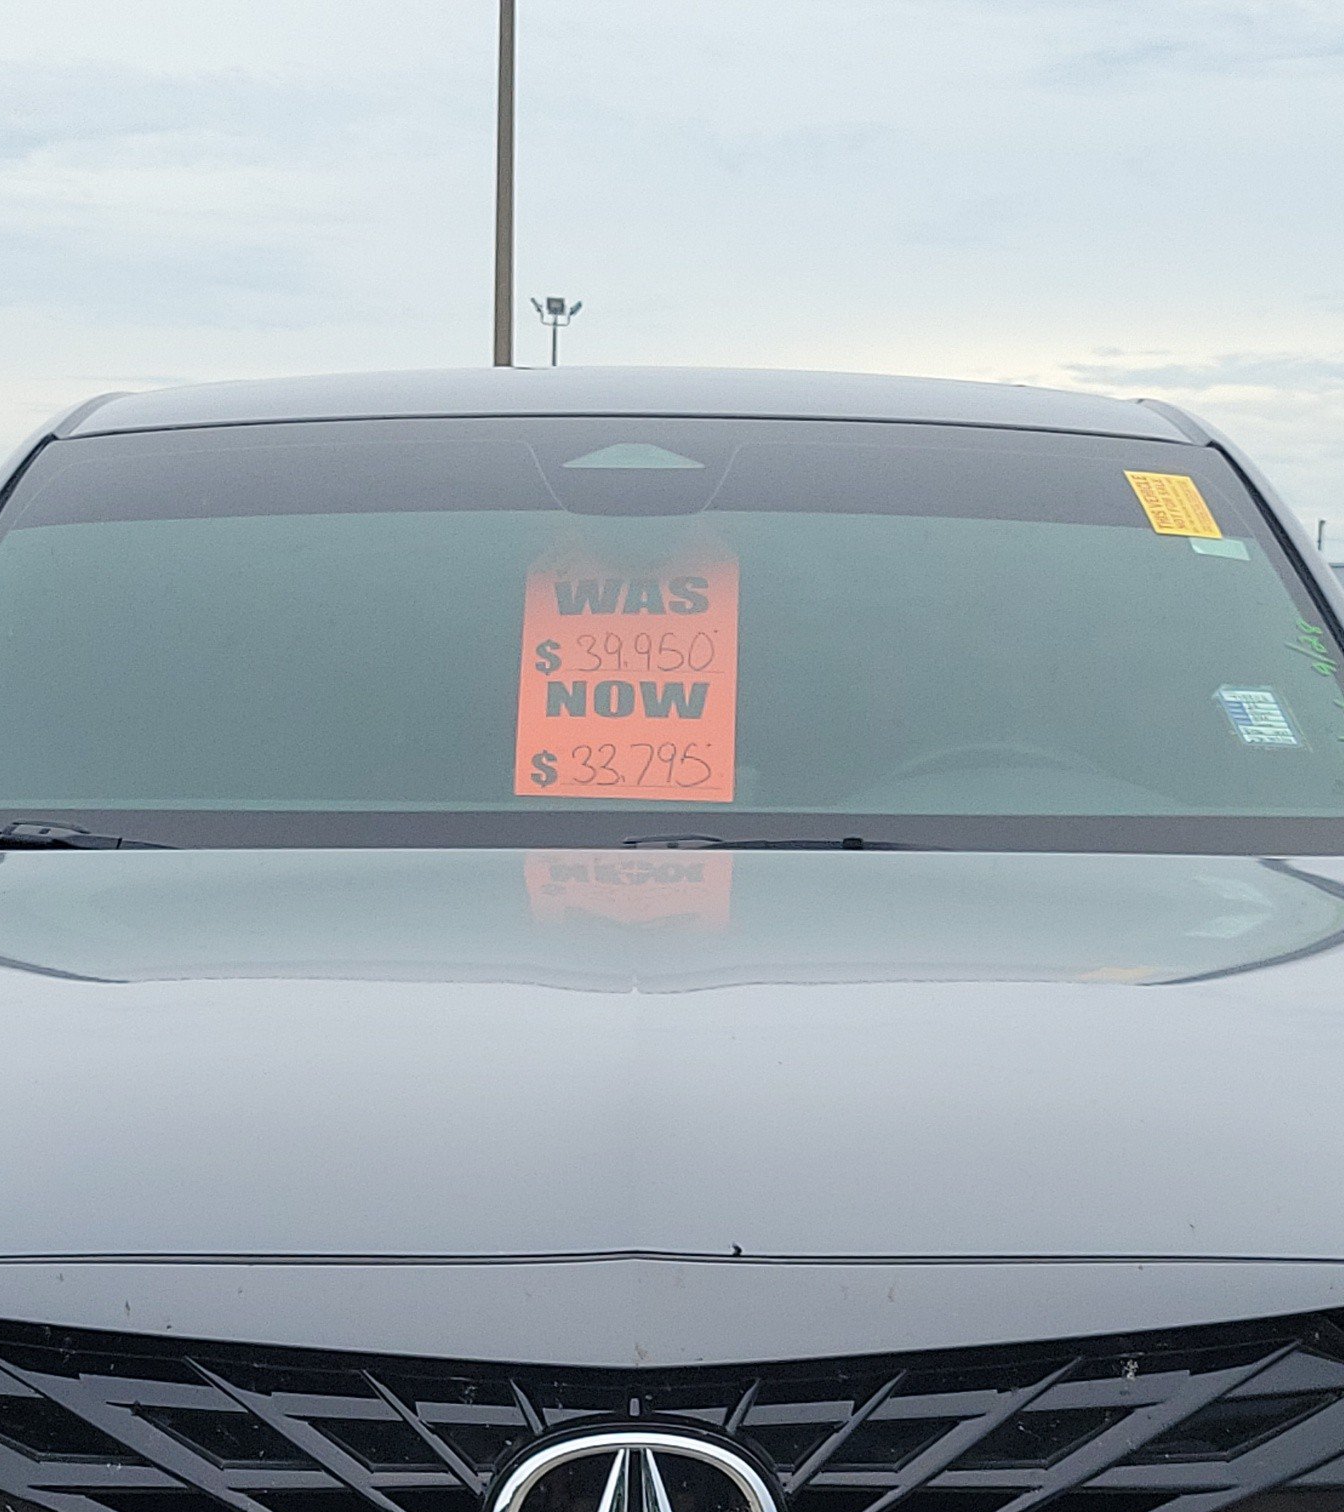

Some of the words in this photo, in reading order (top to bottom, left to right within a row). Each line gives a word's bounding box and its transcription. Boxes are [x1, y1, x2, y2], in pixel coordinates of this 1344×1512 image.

[555, 576, 709, 616] WAS
[534, 639, 562, 675] $
[546, 680, 710, 719] NOW
[530, 750, 558, 788] $
